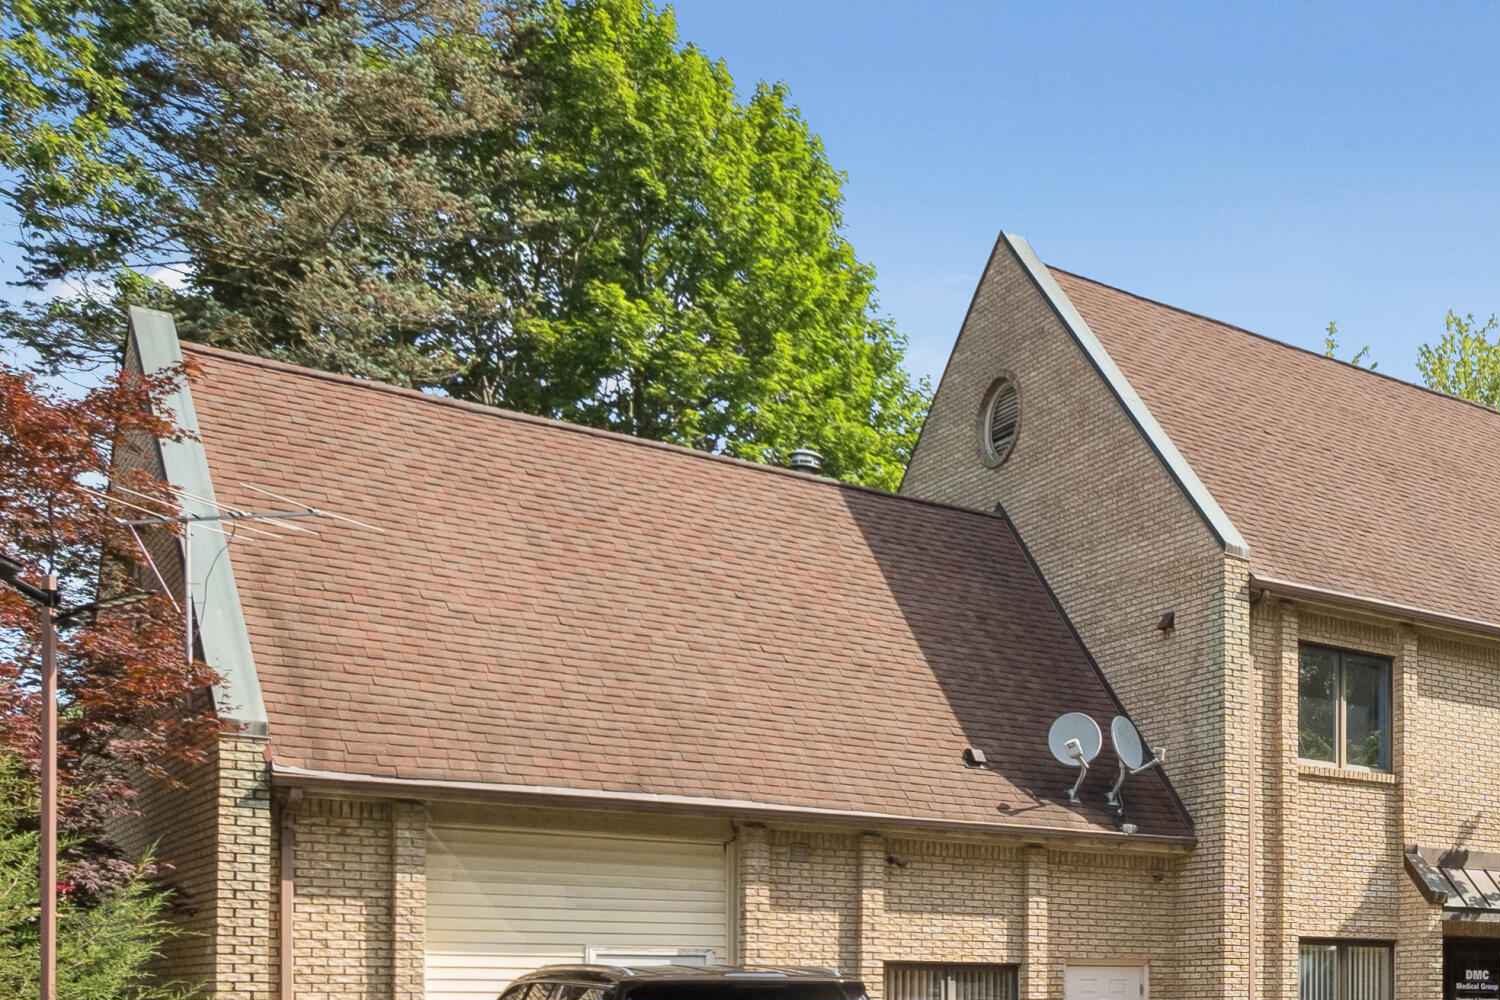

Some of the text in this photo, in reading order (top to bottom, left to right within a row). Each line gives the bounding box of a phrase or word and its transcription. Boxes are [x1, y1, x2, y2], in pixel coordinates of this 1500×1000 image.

[1465, 969, 1489, 980] DMC
[1455, 982, 1499, 991] Medical Group
